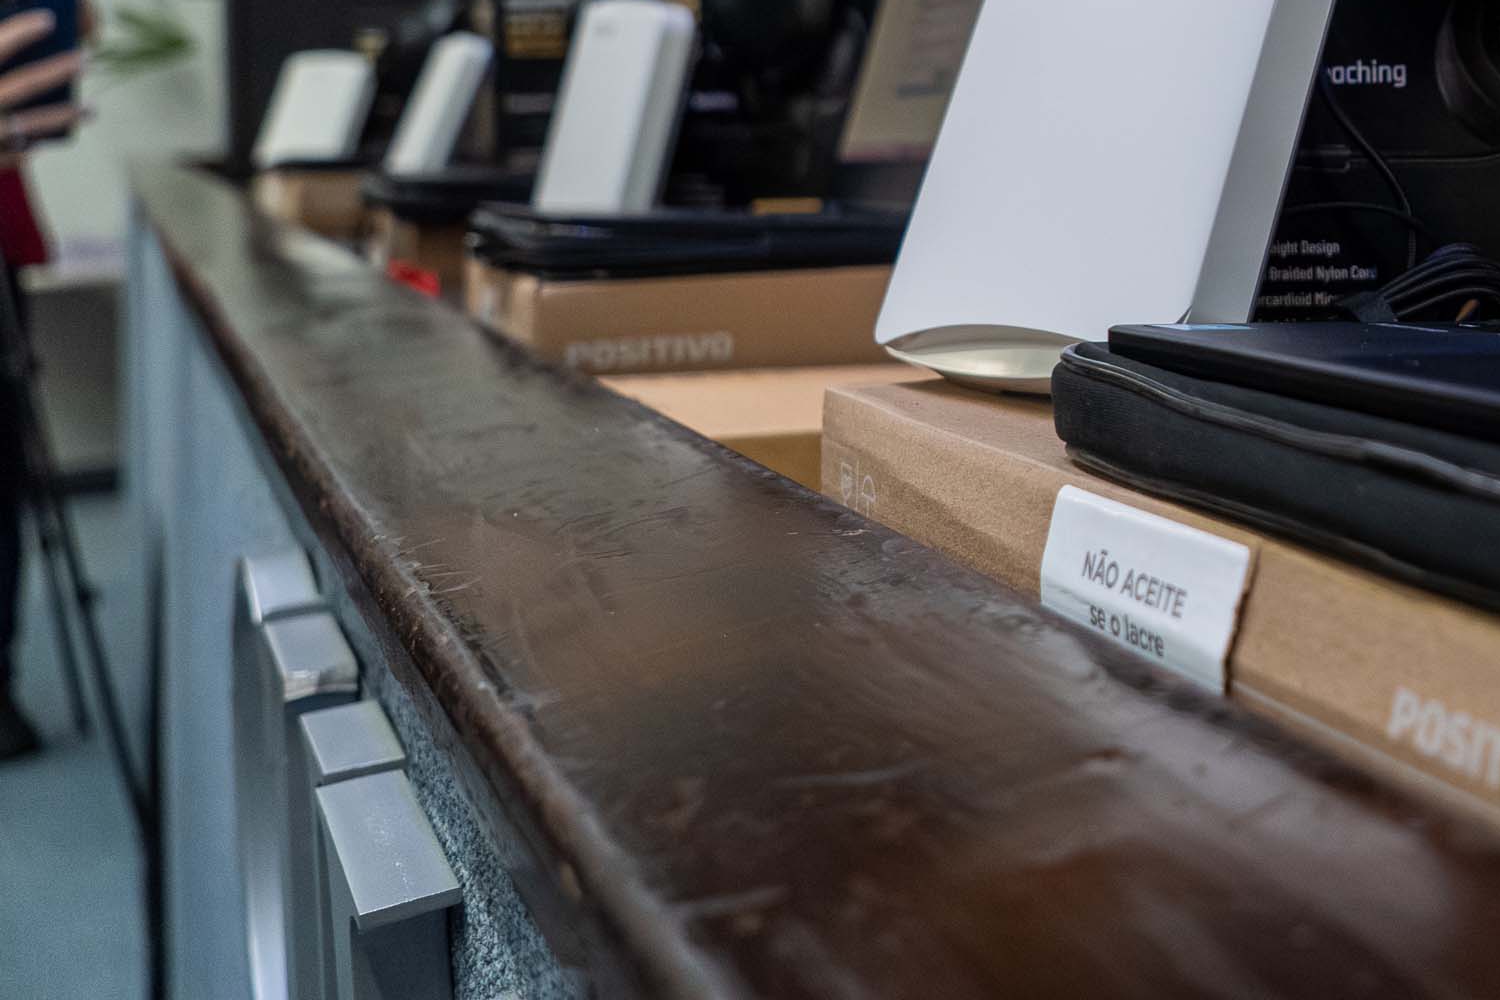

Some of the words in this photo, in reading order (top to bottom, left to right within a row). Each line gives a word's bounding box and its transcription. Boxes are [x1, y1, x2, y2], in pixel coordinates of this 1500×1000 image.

[1327, 59, 1407, 88] aching
[1301, 240, 1341, 258] Design
[1315, 265, 1348, 283] Nylon
[1082, 549, 1119, 589] NÃO
[1120, 567, 1188, 619] ACEITE
[1090, 604, 1107, 630] se
[1110, 615, 1121, 637] o
[1124, 613, 1165, 658] lacre
